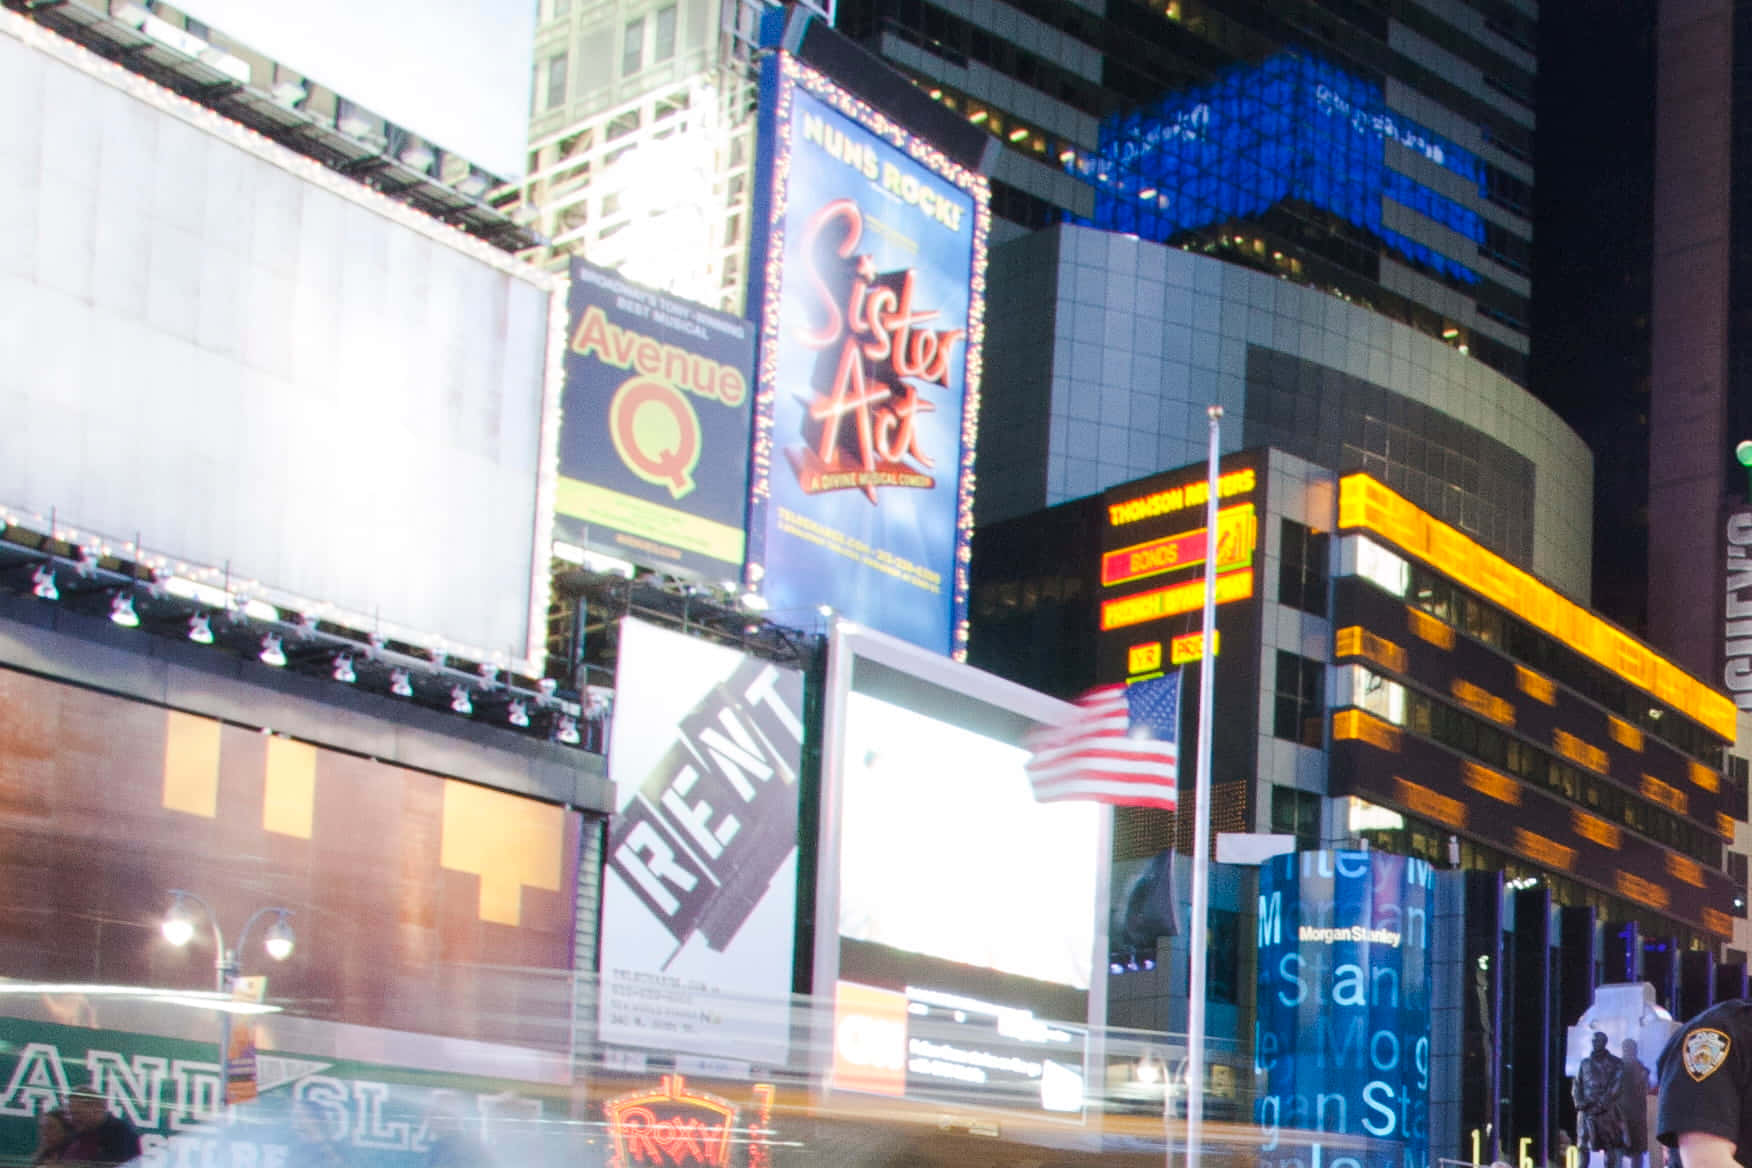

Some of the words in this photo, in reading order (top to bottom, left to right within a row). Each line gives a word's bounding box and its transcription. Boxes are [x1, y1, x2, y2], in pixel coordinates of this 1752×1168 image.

[803, 110, 879, 181] NUNS
[793, 198, 966, 388] Sister
[571, 303, 747, 408] Avenue
[609, 373, 702, 500] Q
[811, 340, 938, 505] Act
[1108, 486, 1184, 527] THOMSON
[1130, 543, 1179, 573] BONDS
[613, 662, 804, 917] RENT
[1299, 925, 1351, 947] Morgan
[1351, 926, 1401, 949] Stanley
